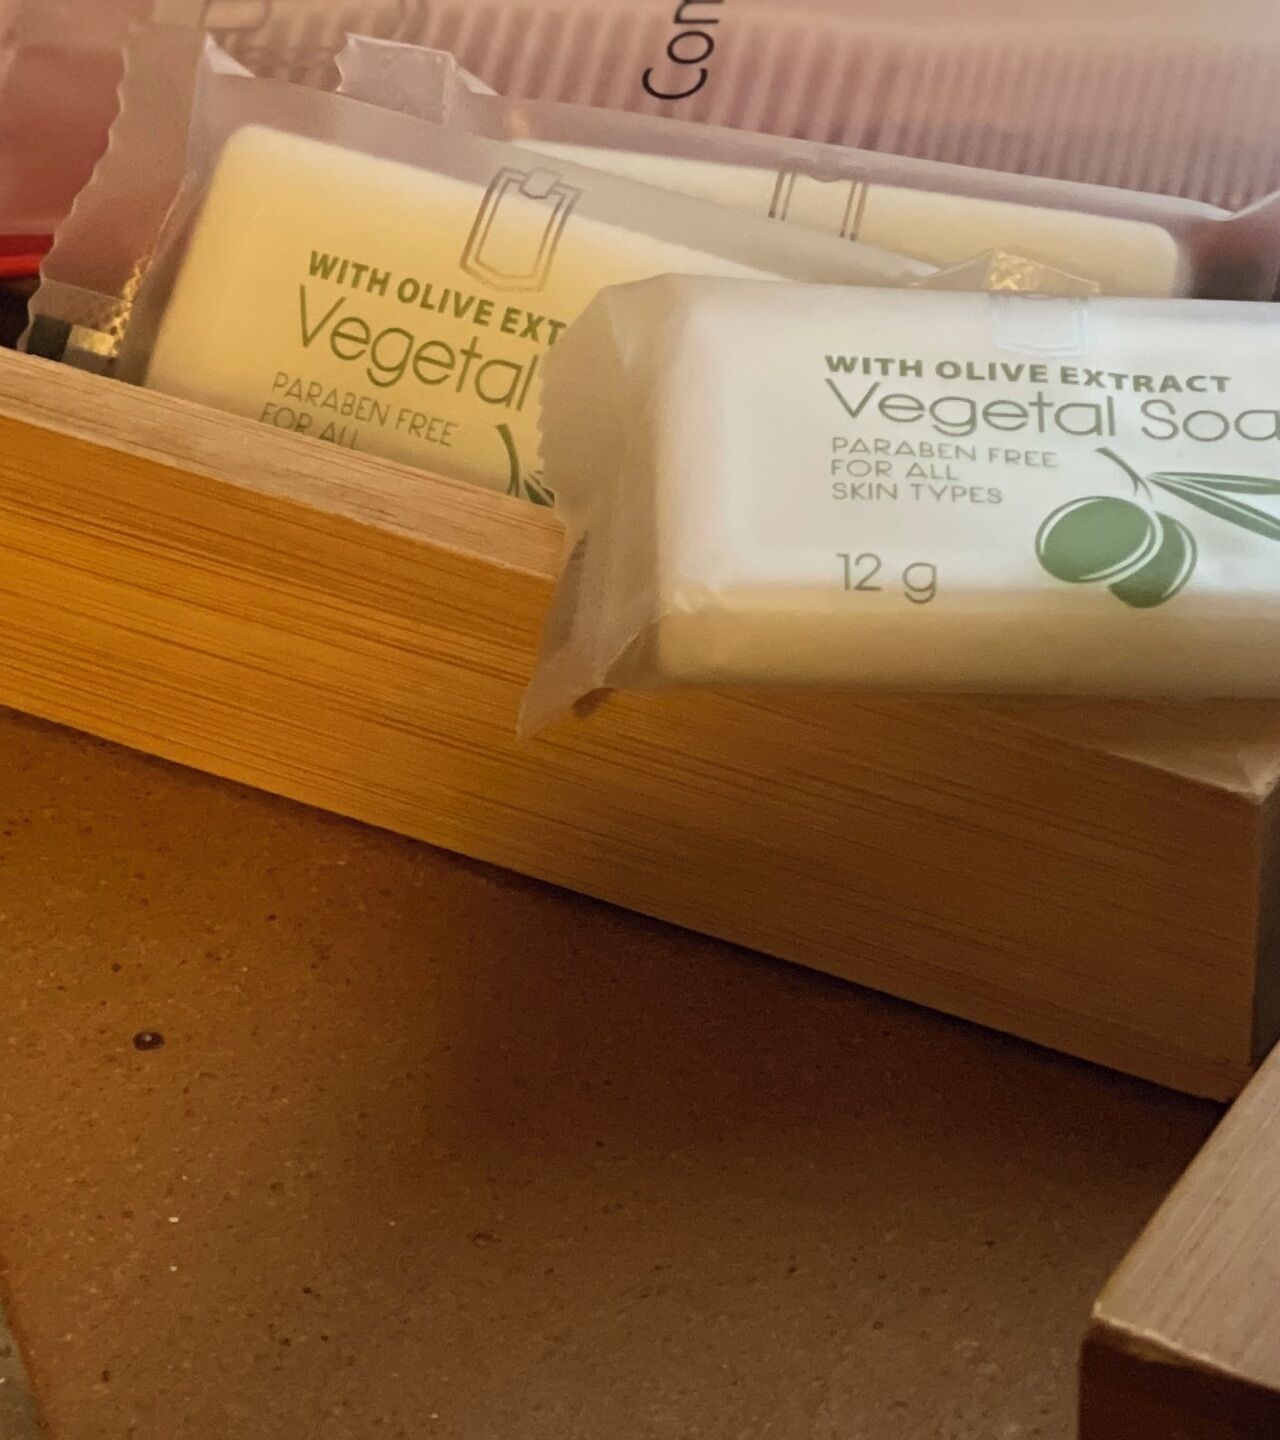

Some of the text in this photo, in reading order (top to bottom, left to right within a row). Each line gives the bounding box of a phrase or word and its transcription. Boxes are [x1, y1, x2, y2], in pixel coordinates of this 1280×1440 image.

[308, 249, 391, 297] WITH
[396, 277, 495, 328] OLIVE
[299, 283, 540, 413] Vegetal
[823, 354, 1232, 394] WITH OLIVE EXTRACT
[259, 402, 314, 436] FOR
[271, 371, 460, 448] PARABEN FREE
[824, 377, 1116, 438] Vegetal
[830, 458, 960, 481] FOR ALL
[831, 436, 1060, 469] PARABEN FREE
[831, 481, 1003, 505] SKIN TYPES
[834, 551, 938, 605] 12 g
